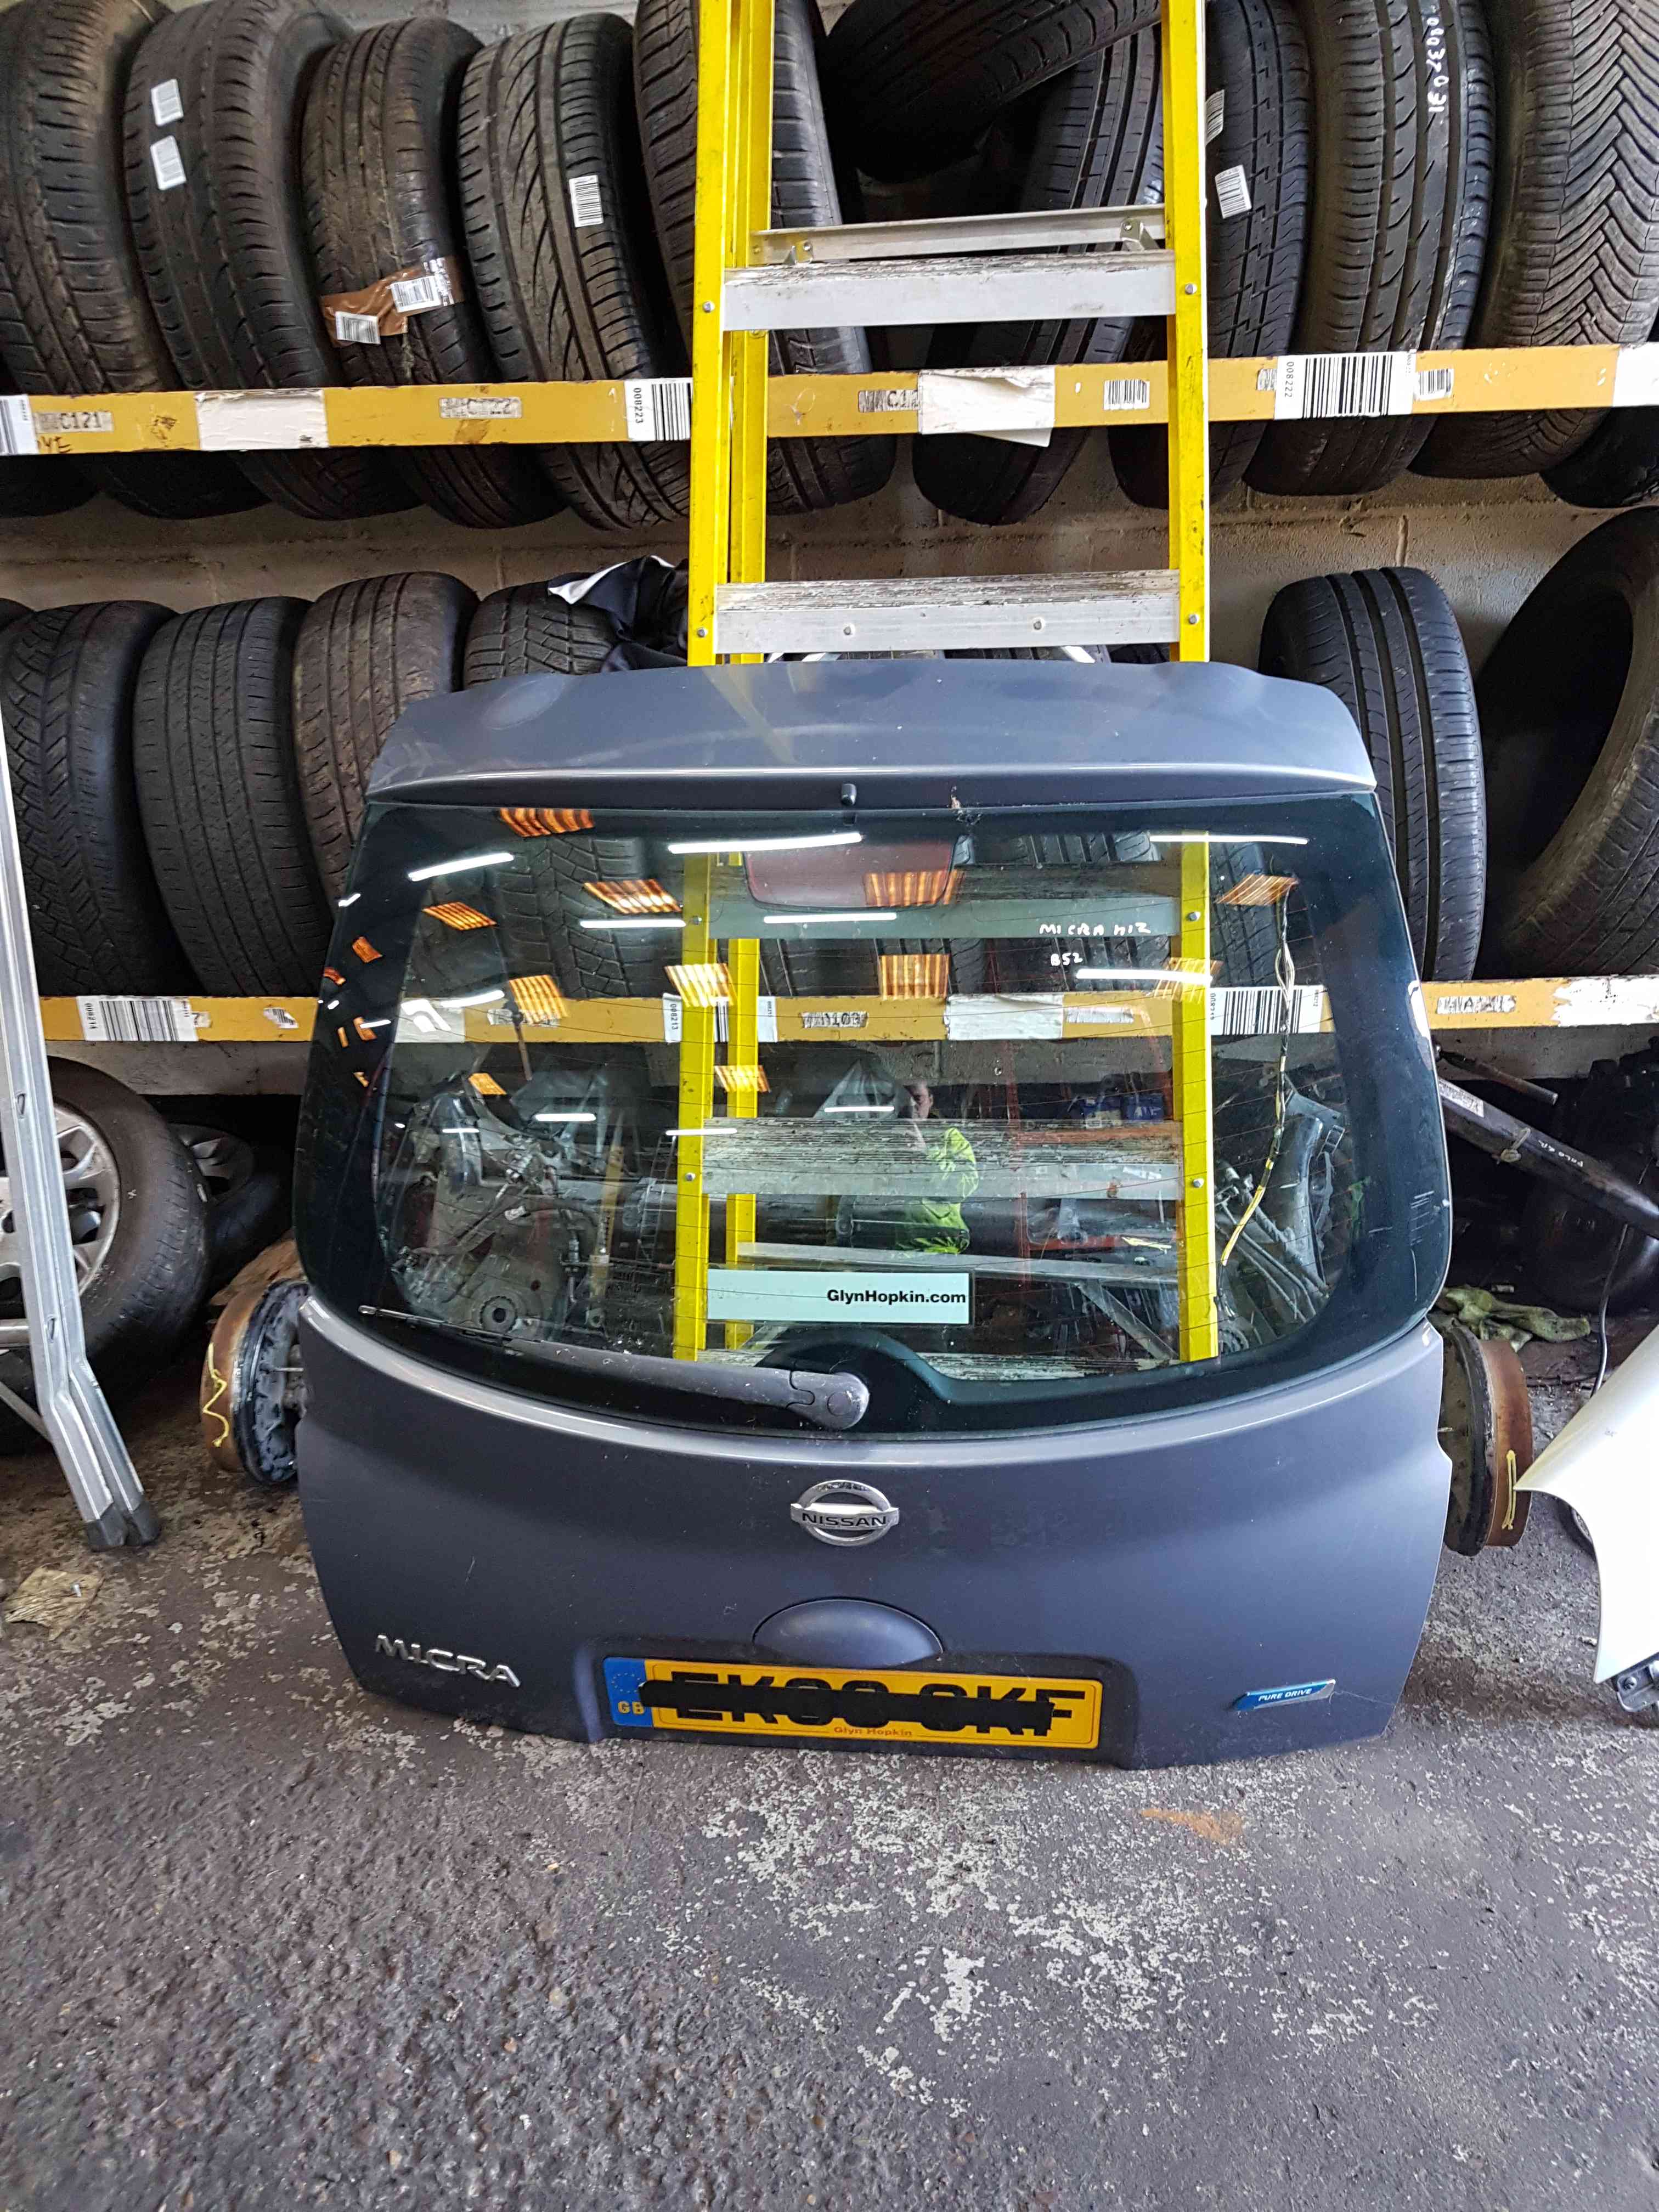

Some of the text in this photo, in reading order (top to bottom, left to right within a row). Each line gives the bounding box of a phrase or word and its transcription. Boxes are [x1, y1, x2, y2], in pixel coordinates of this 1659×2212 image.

[1285, 362, 1294, 398] 008222
[633, 387, 644, 424] 008223
[670, 1003, 679, 1030] 008213
[827, 1289, 966, 1305] GlynHopkin.com
[802, 1513, 887, 1526] NISSAN
[375, 1635, 521, 1688] MICRA
[1259, 1688, 1313, 1701] PURE DRIVE
[618, 1701, 645, 1714] GB
[834, 1726, 861, 1735] Glyn
